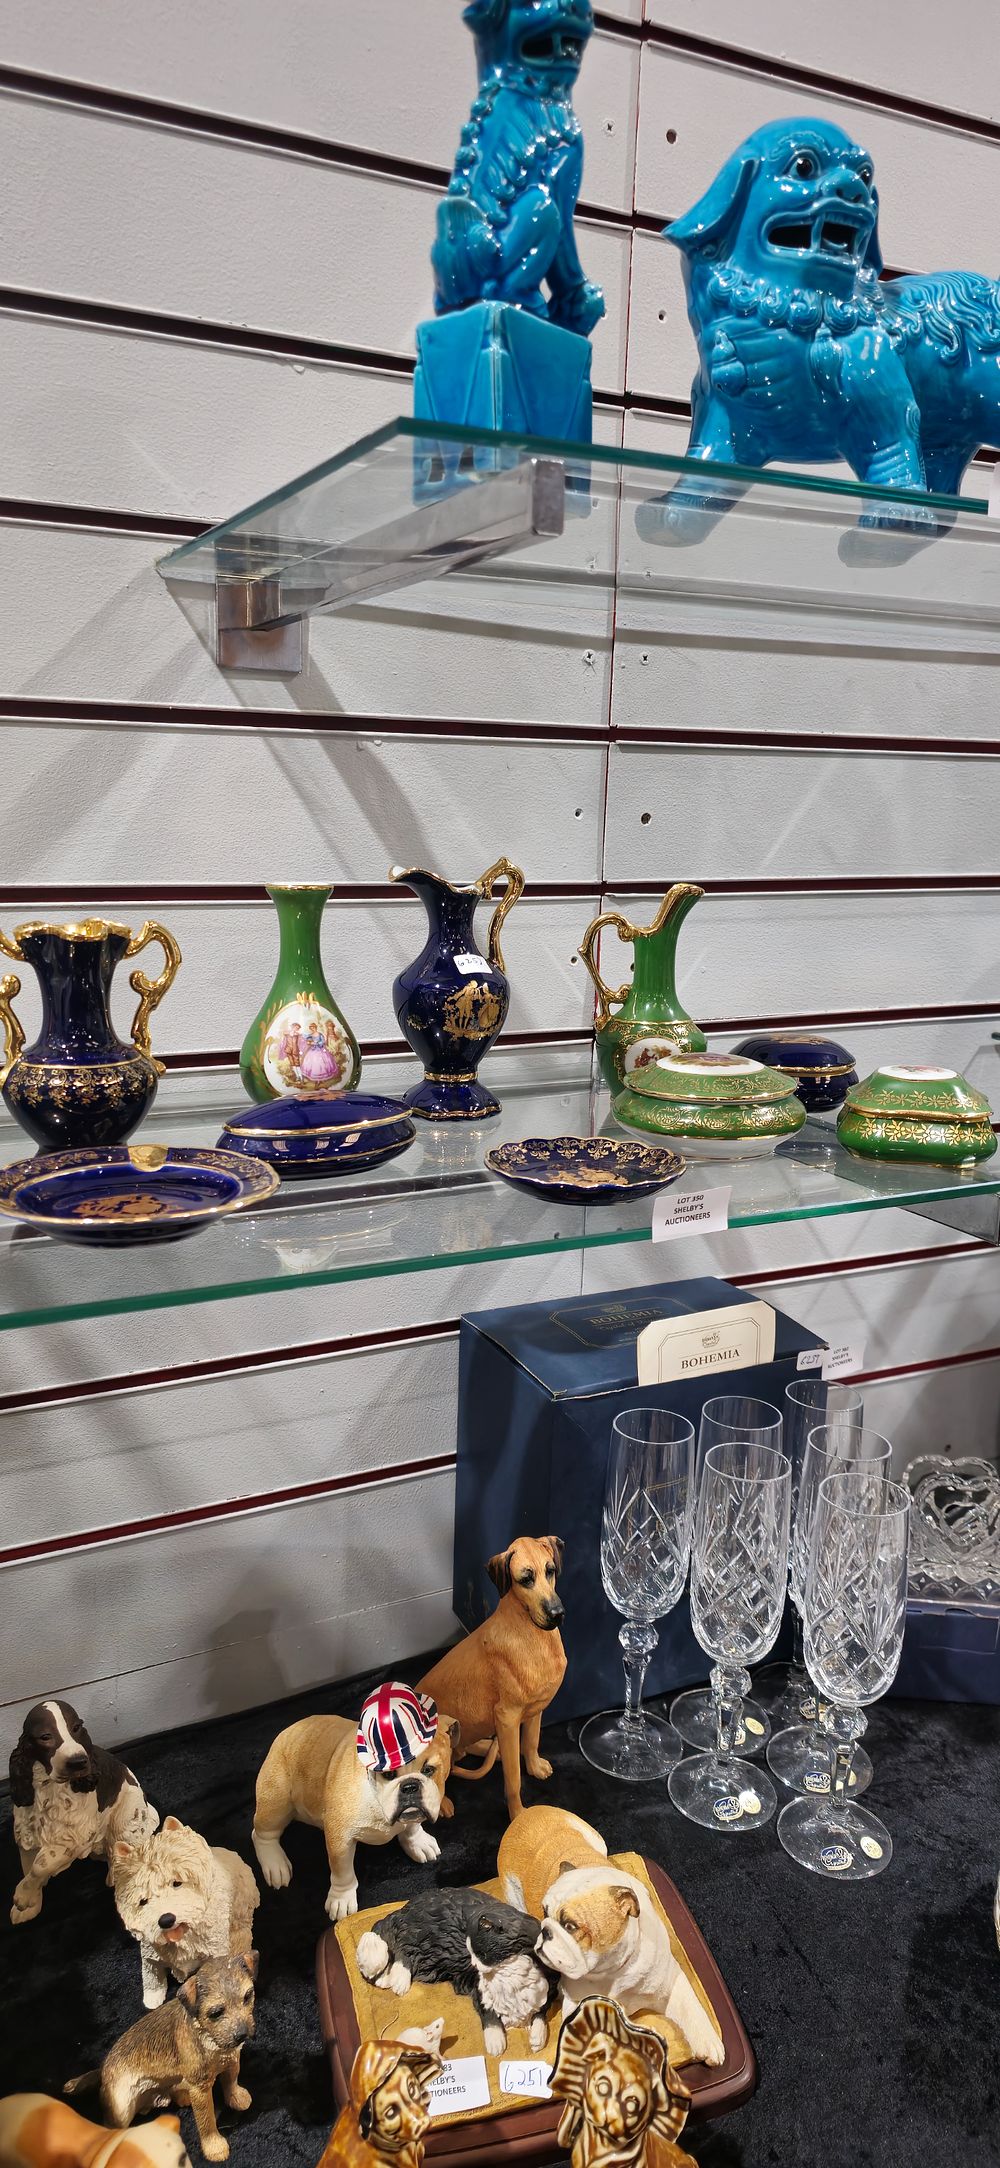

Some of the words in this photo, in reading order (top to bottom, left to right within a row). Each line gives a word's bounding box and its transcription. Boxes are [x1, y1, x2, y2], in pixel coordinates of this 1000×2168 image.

[692, 1194, 704, 1202] 350
[673, 1203, 704, 1215] SHELBY'S
[664, 1211, 711, 1226] AUCTIONEERS
[589, 1308, 662, 1325] BOHEMIA
[681, 1349, 740, 1369] BOHEMIA
[442, 2063, 452, 2072] 83
[431, 2075, 456, 2087] ELBY'S
[504, 2064, 542, 2092] 6251
[430, 2085, 466, 2098] TIONEERS
